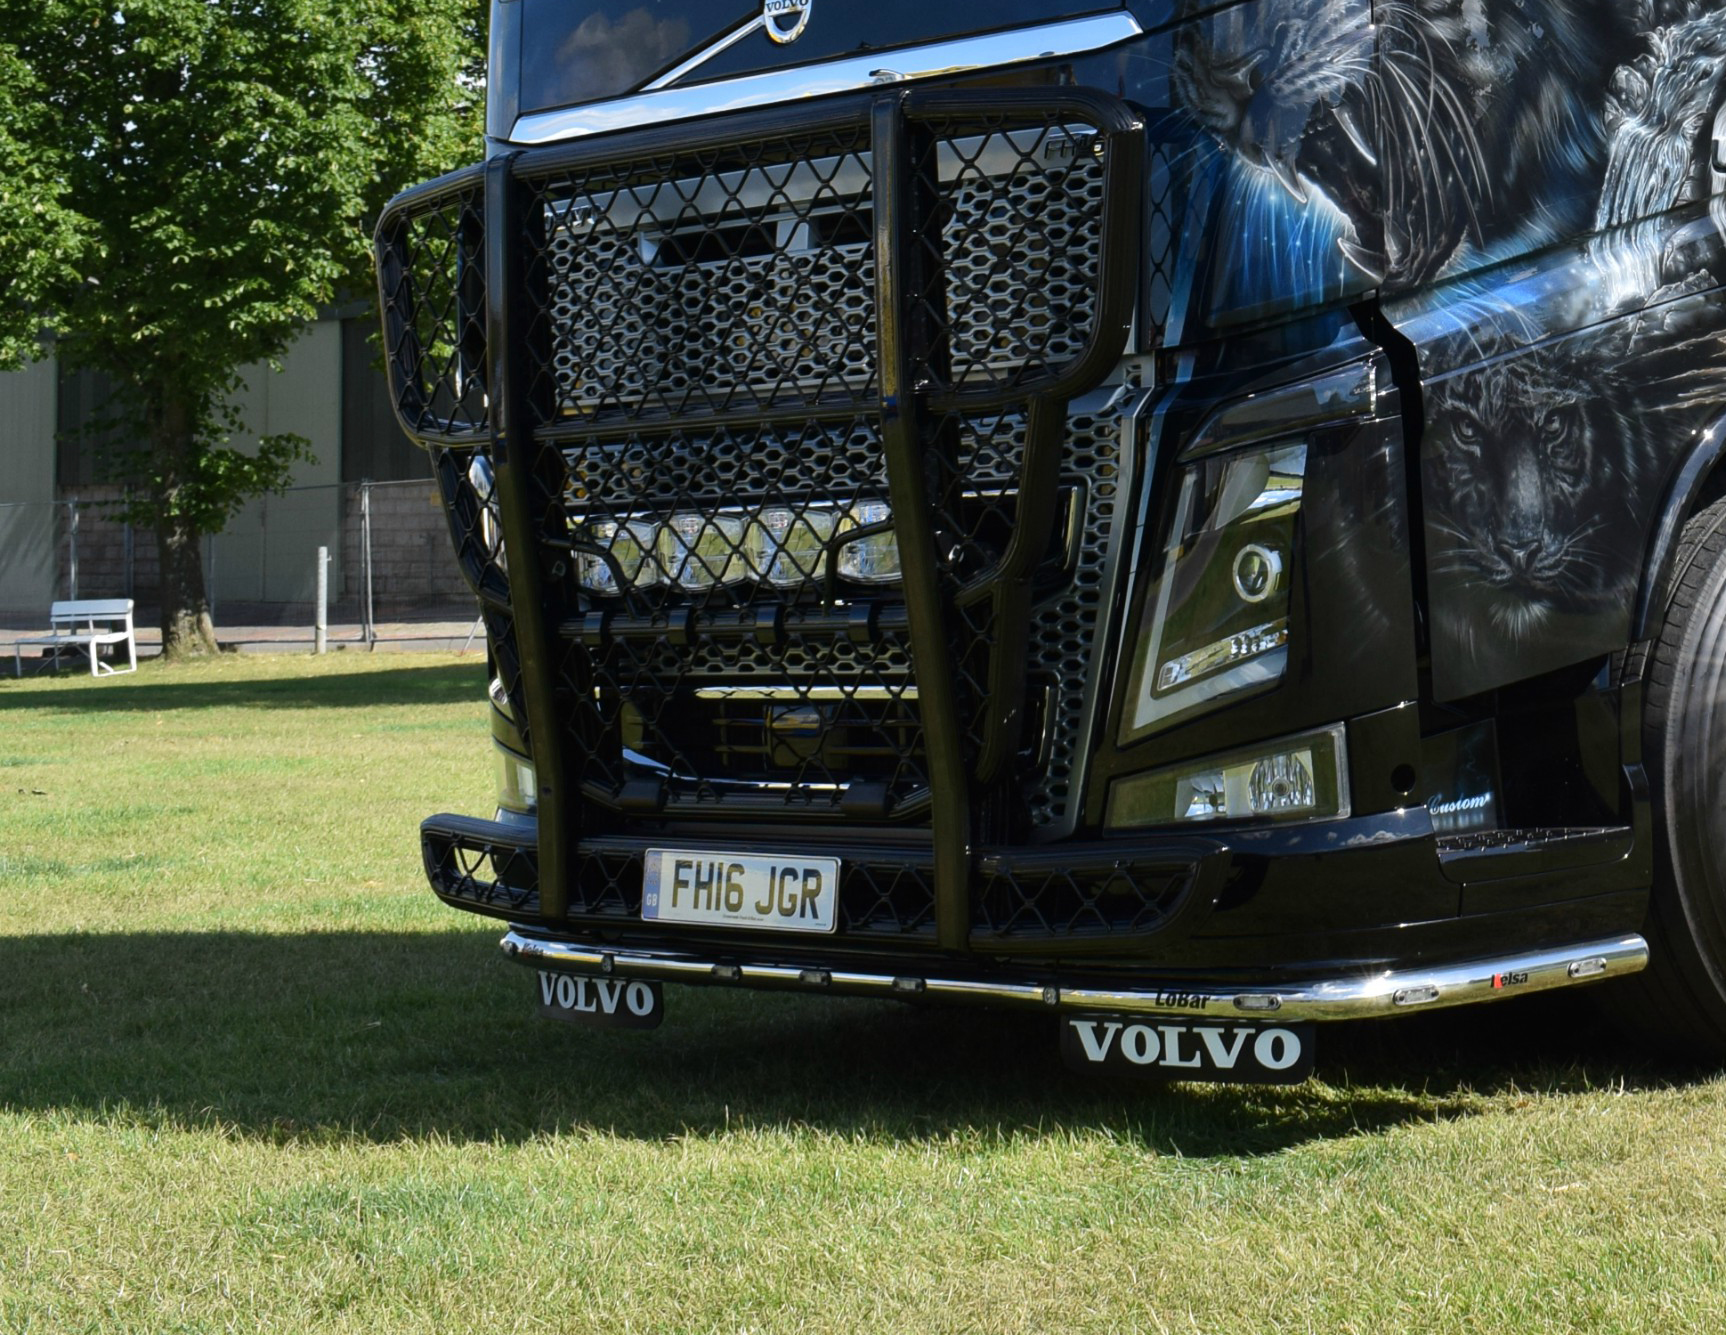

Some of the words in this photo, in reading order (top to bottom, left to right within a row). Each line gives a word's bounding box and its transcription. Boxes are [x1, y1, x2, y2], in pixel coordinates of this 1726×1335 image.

[646, 893, 657, 907] GB
[672, 859, 746, 912] FH16
[755, 866, 823, 919] JGR
[538, 970, 655, 1016] VOLVO
[1155, 988, 1211, 1010] LoBar
[1069, 1020, 1301, 1070] VOLVO
